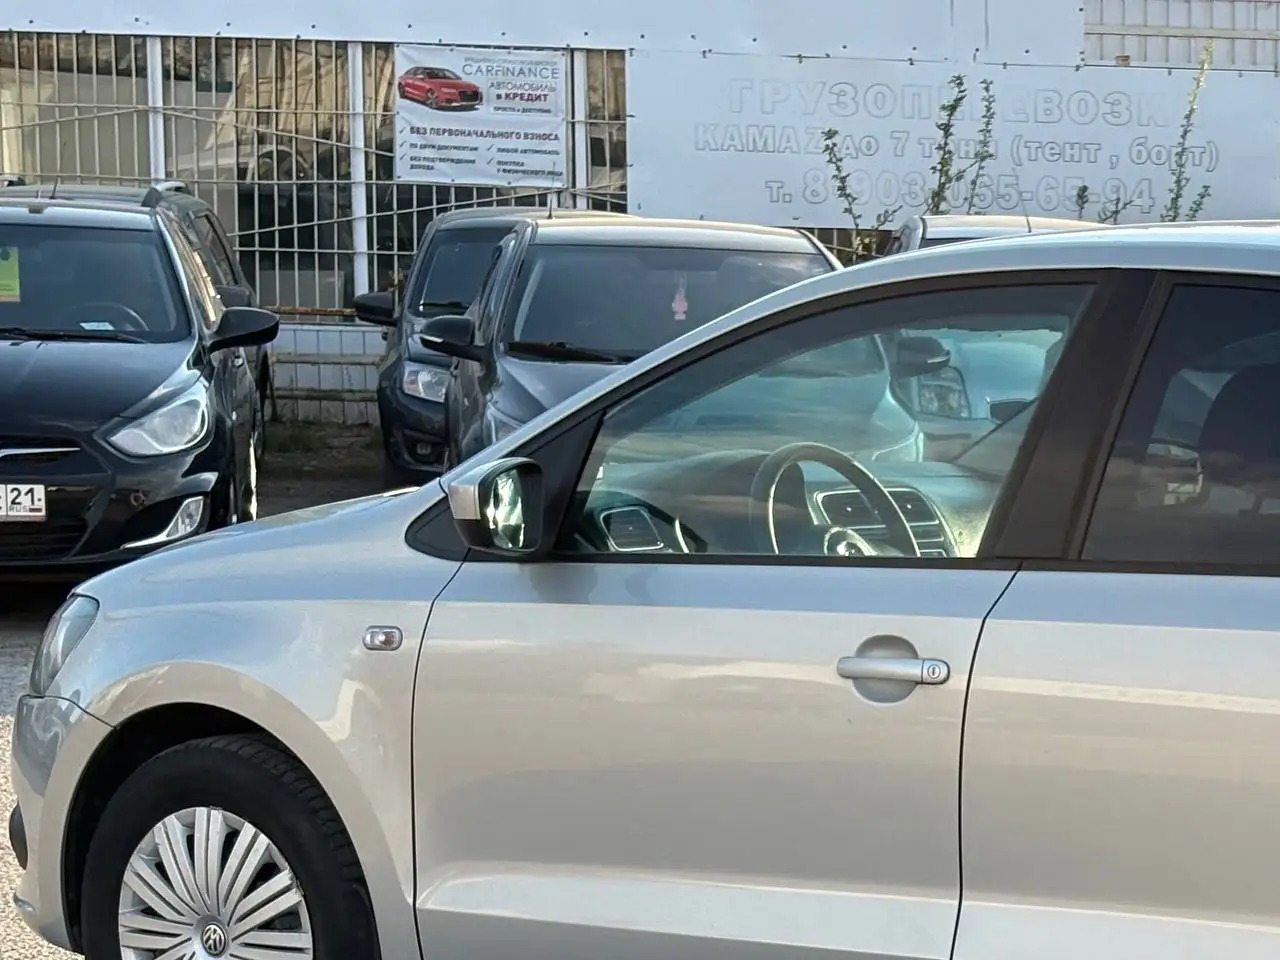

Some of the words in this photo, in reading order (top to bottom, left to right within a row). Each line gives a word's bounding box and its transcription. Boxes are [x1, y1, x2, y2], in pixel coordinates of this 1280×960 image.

[462, 64, 560, 79] CARFINANCE
[488, 81, 558, 92] АВТОМОБИЛЬ
[504, 92, 549, 102] КРЕДИТ
[728, 78, 1203, 127] ГРУЗОПЕЕВОЗК
[410, 126, 428, 136] БЕЗ
[429, 127, 522, 140] ПЕРВОНАЧАЛЬНОГО
[523, 131, 560, 141] ВЗНОСА
[890, 130, 910, 158] 7
[10, 487, 35, 506] 21
